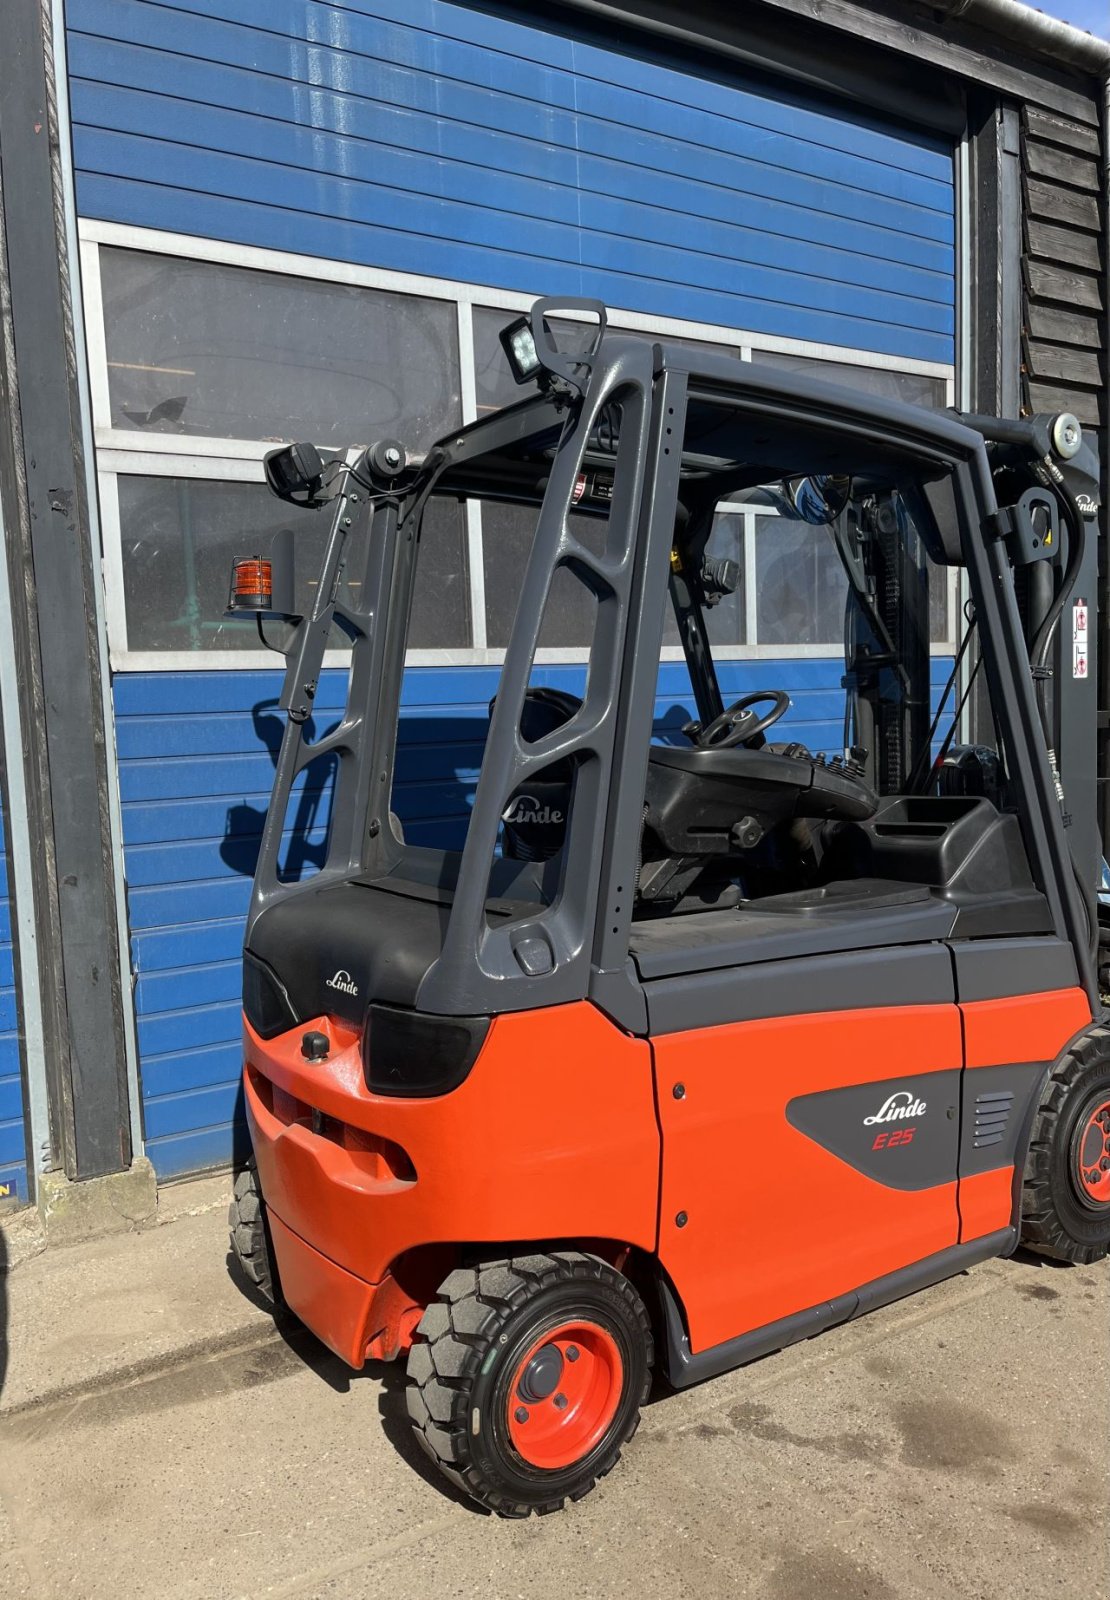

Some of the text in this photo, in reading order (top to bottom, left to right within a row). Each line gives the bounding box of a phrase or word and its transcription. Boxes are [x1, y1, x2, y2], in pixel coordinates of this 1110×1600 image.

[501, 795, 564, 823] Linde
[326, 970, 358, 996] Linde
[863, 1091, 927, 1126] Linde
